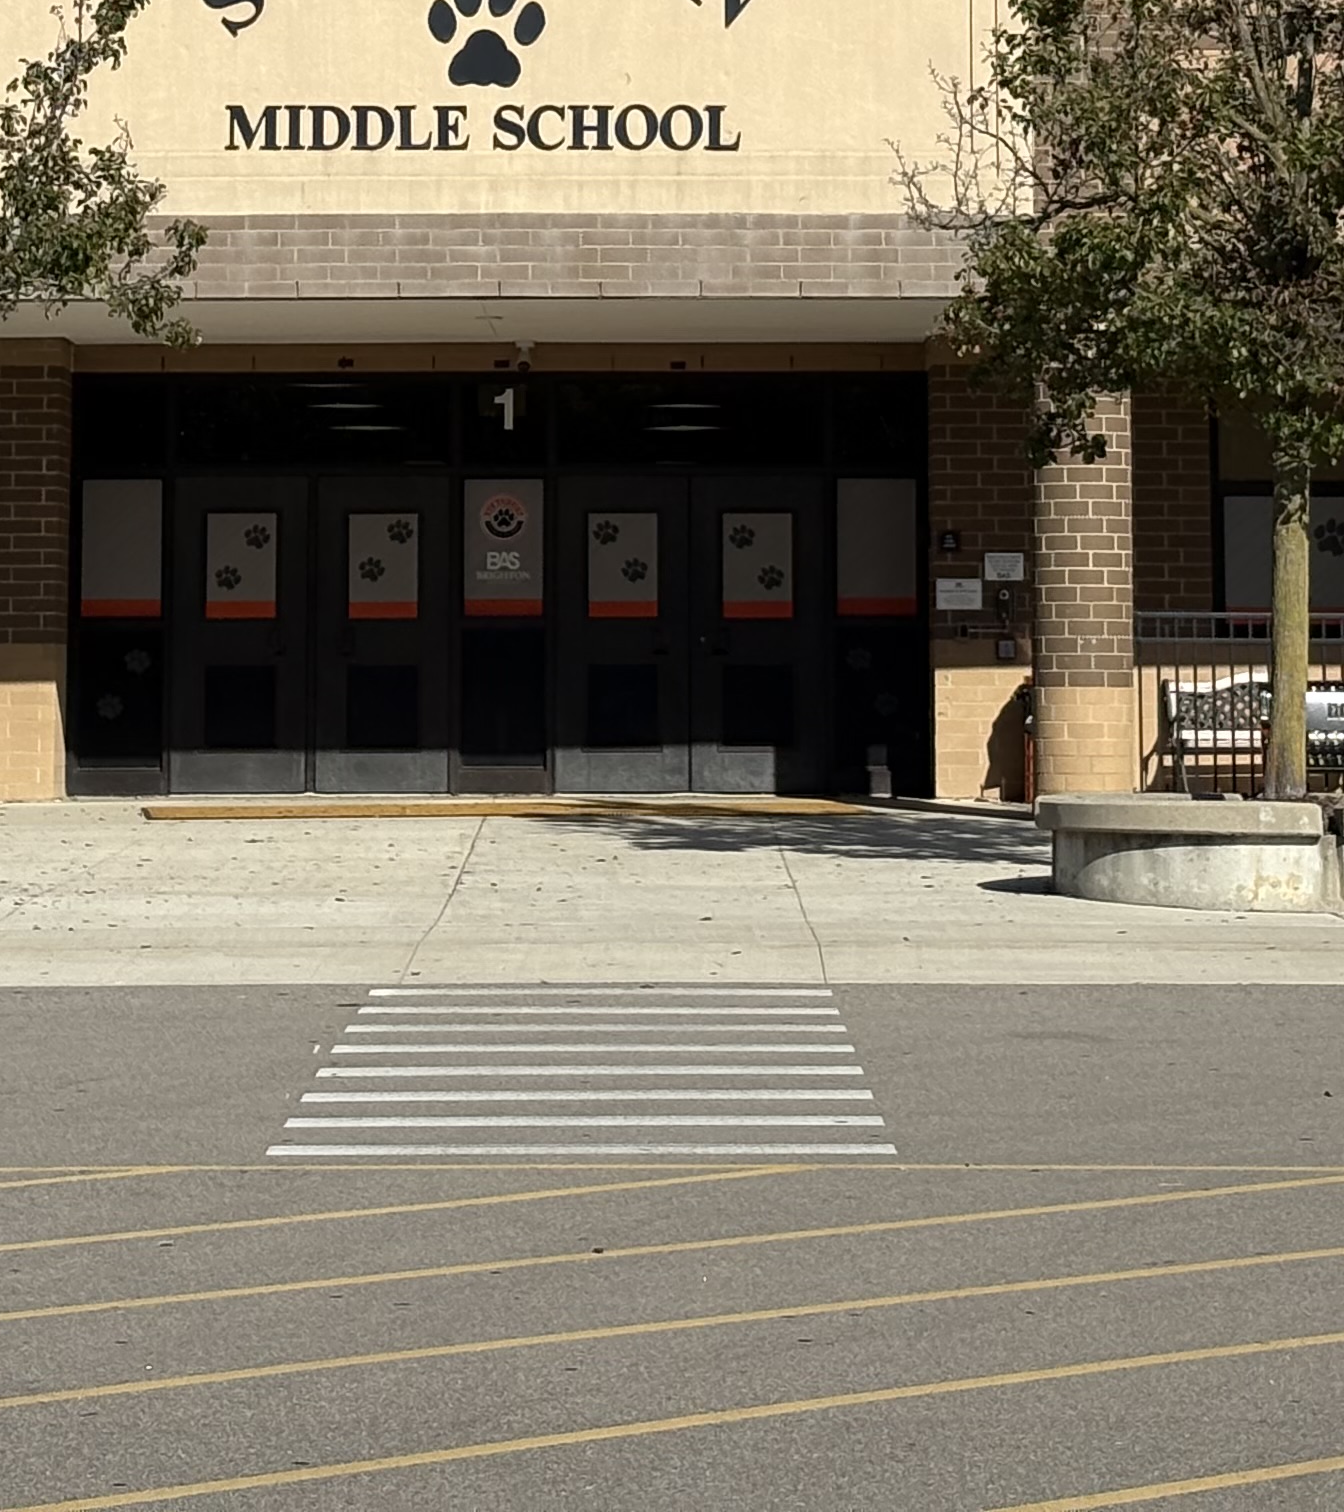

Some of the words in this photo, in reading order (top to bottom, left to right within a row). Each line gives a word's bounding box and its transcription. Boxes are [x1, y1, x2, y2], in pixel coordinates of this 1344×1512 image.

[225, 104, 469, 152] MIDDLE
[493, 104, 741, 152] SCHOOL
[493, 387, 515, 431] 1
[486, 551, 520, 570] BAS
